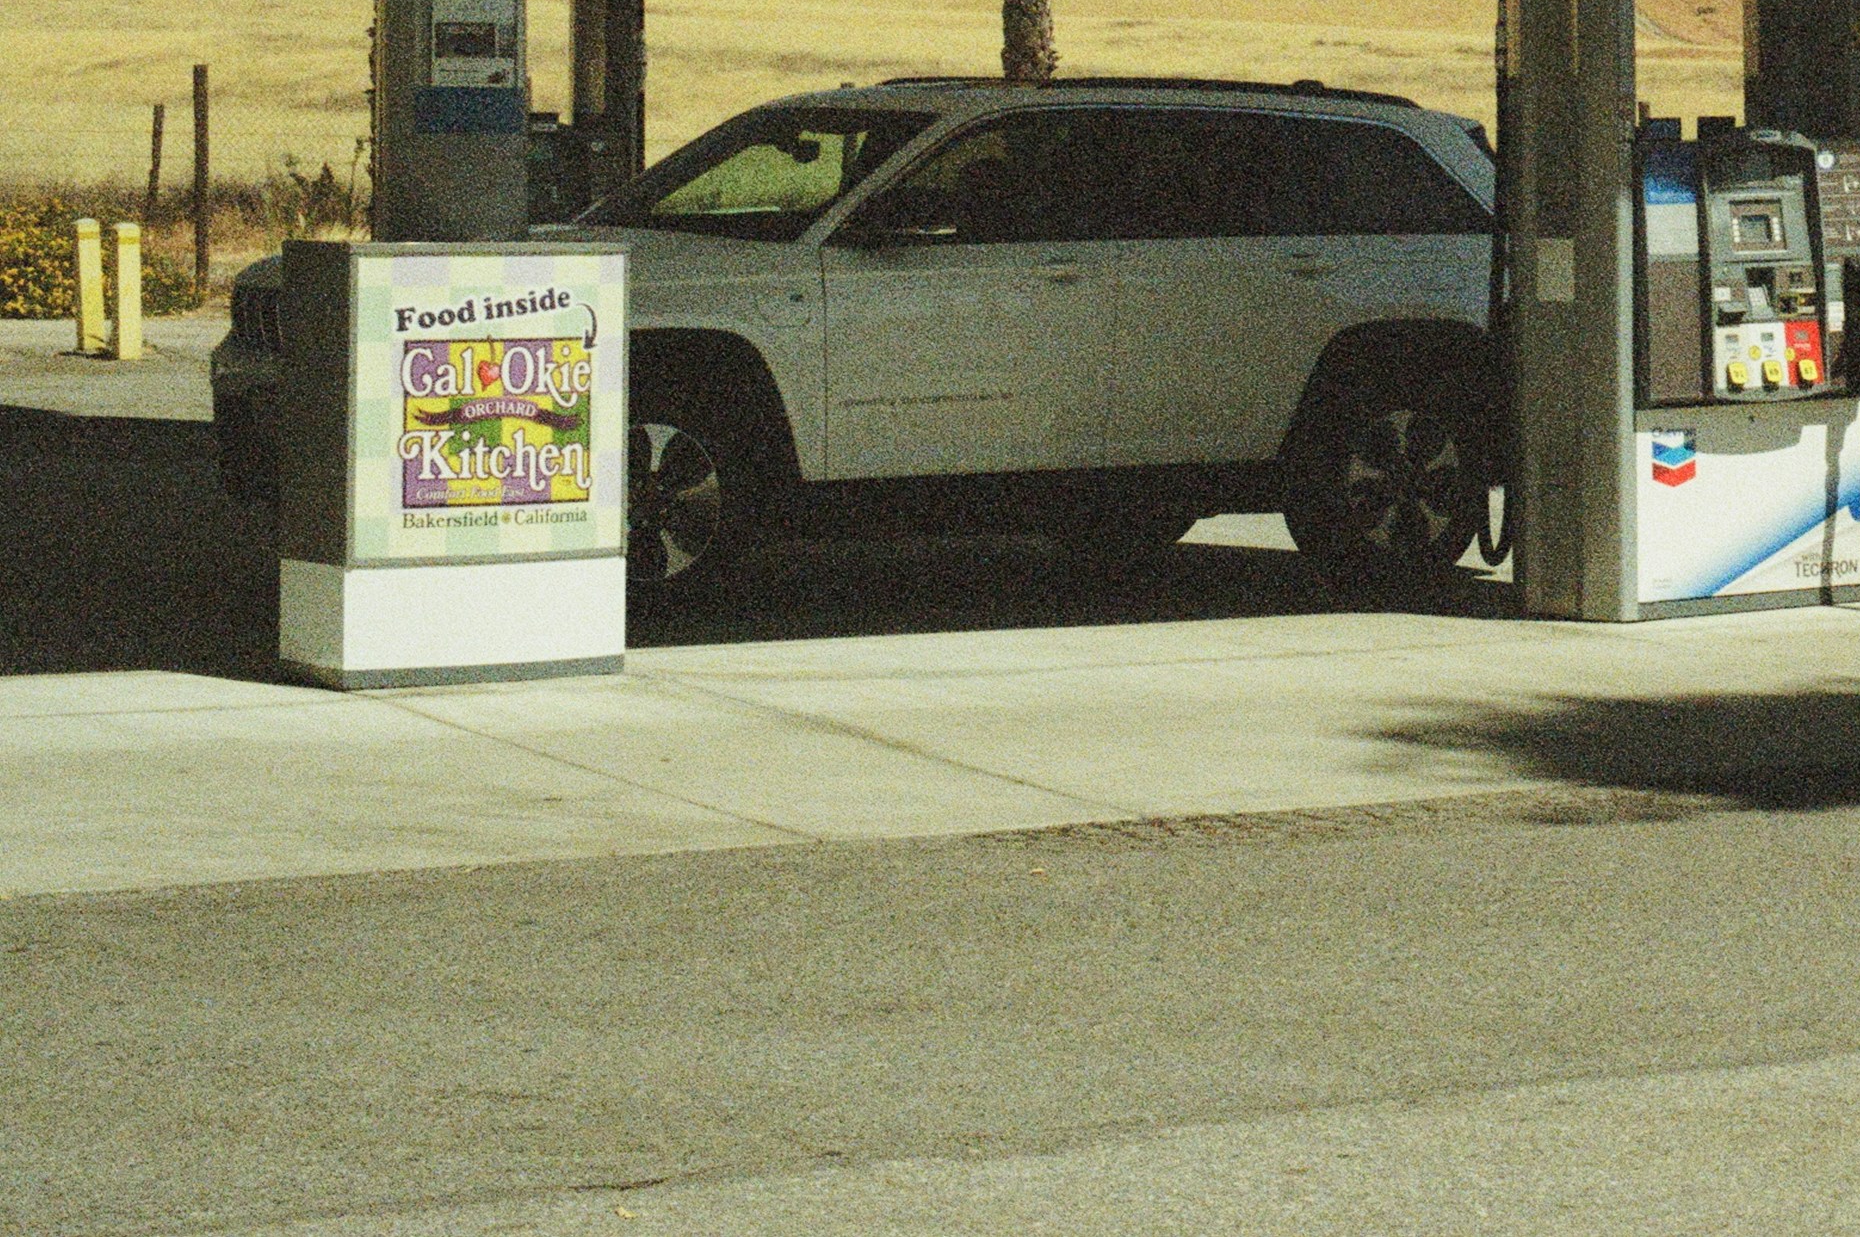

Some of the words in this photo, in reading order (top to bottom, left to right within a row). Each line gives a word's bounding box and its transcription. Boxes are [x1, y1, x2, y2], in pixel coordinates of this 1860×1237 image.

[395, 299, 475, 332] Food
[484, 287, 571, 320] inside
[401, 346, 474, 397] Cal
[502, 345, 591, 408] Okie
[465, 399, 537, 418] ORCHARD
[398, 428, 592, 492] Kitchen
[402, 512, 498, 529] Bakersfield
[514, 509, 588, 527] California
